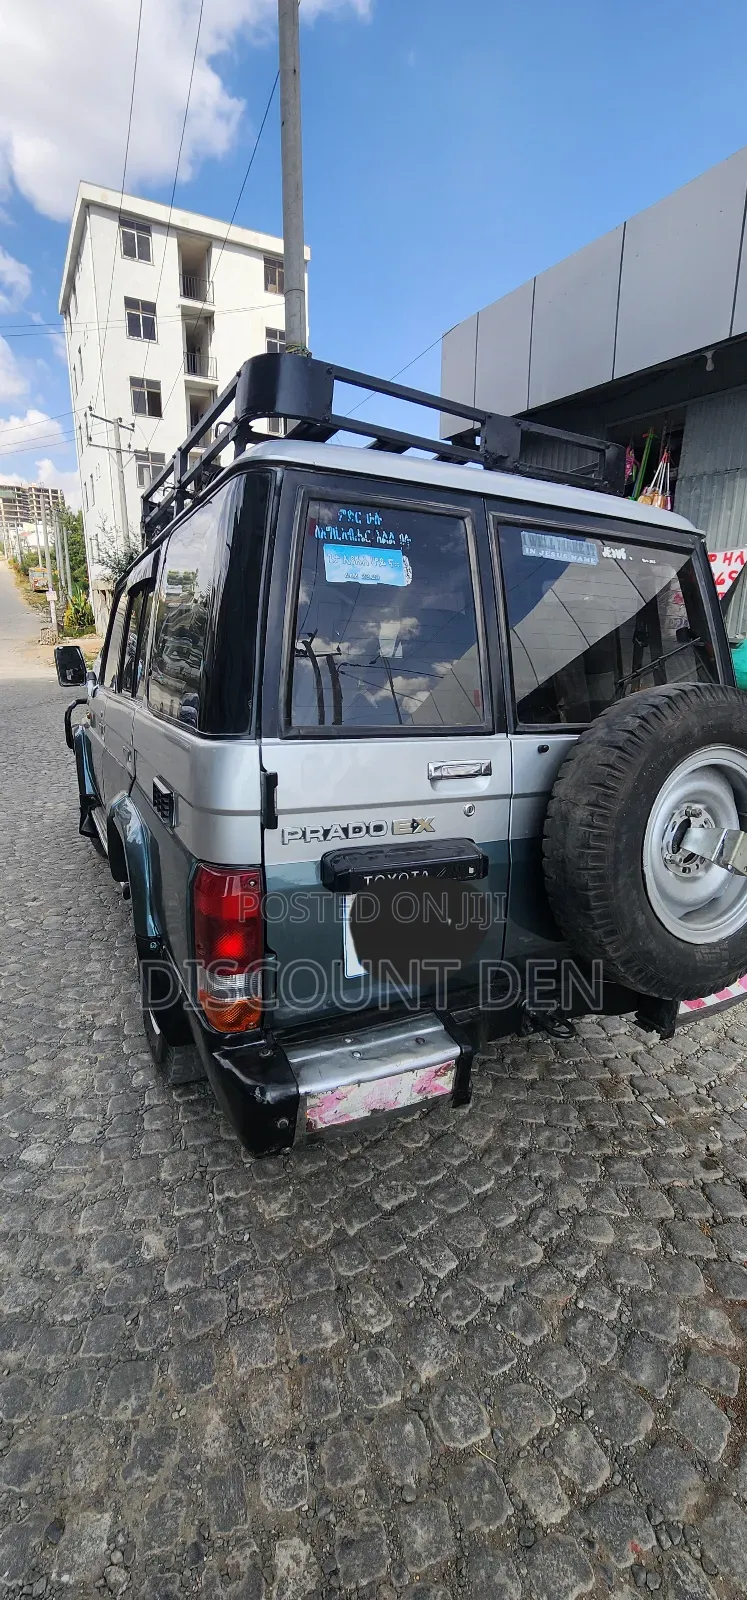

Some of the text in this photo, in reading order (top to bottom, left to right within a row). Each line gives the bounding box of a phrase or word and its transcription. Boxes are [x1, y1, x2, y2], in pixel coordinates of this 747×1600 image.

[338, 509, 383, 525] ምድር ሁሉ
[525, 547, 597, 564] IN JESUS NAME
[281, 816, 437, 846] PRADO EX
